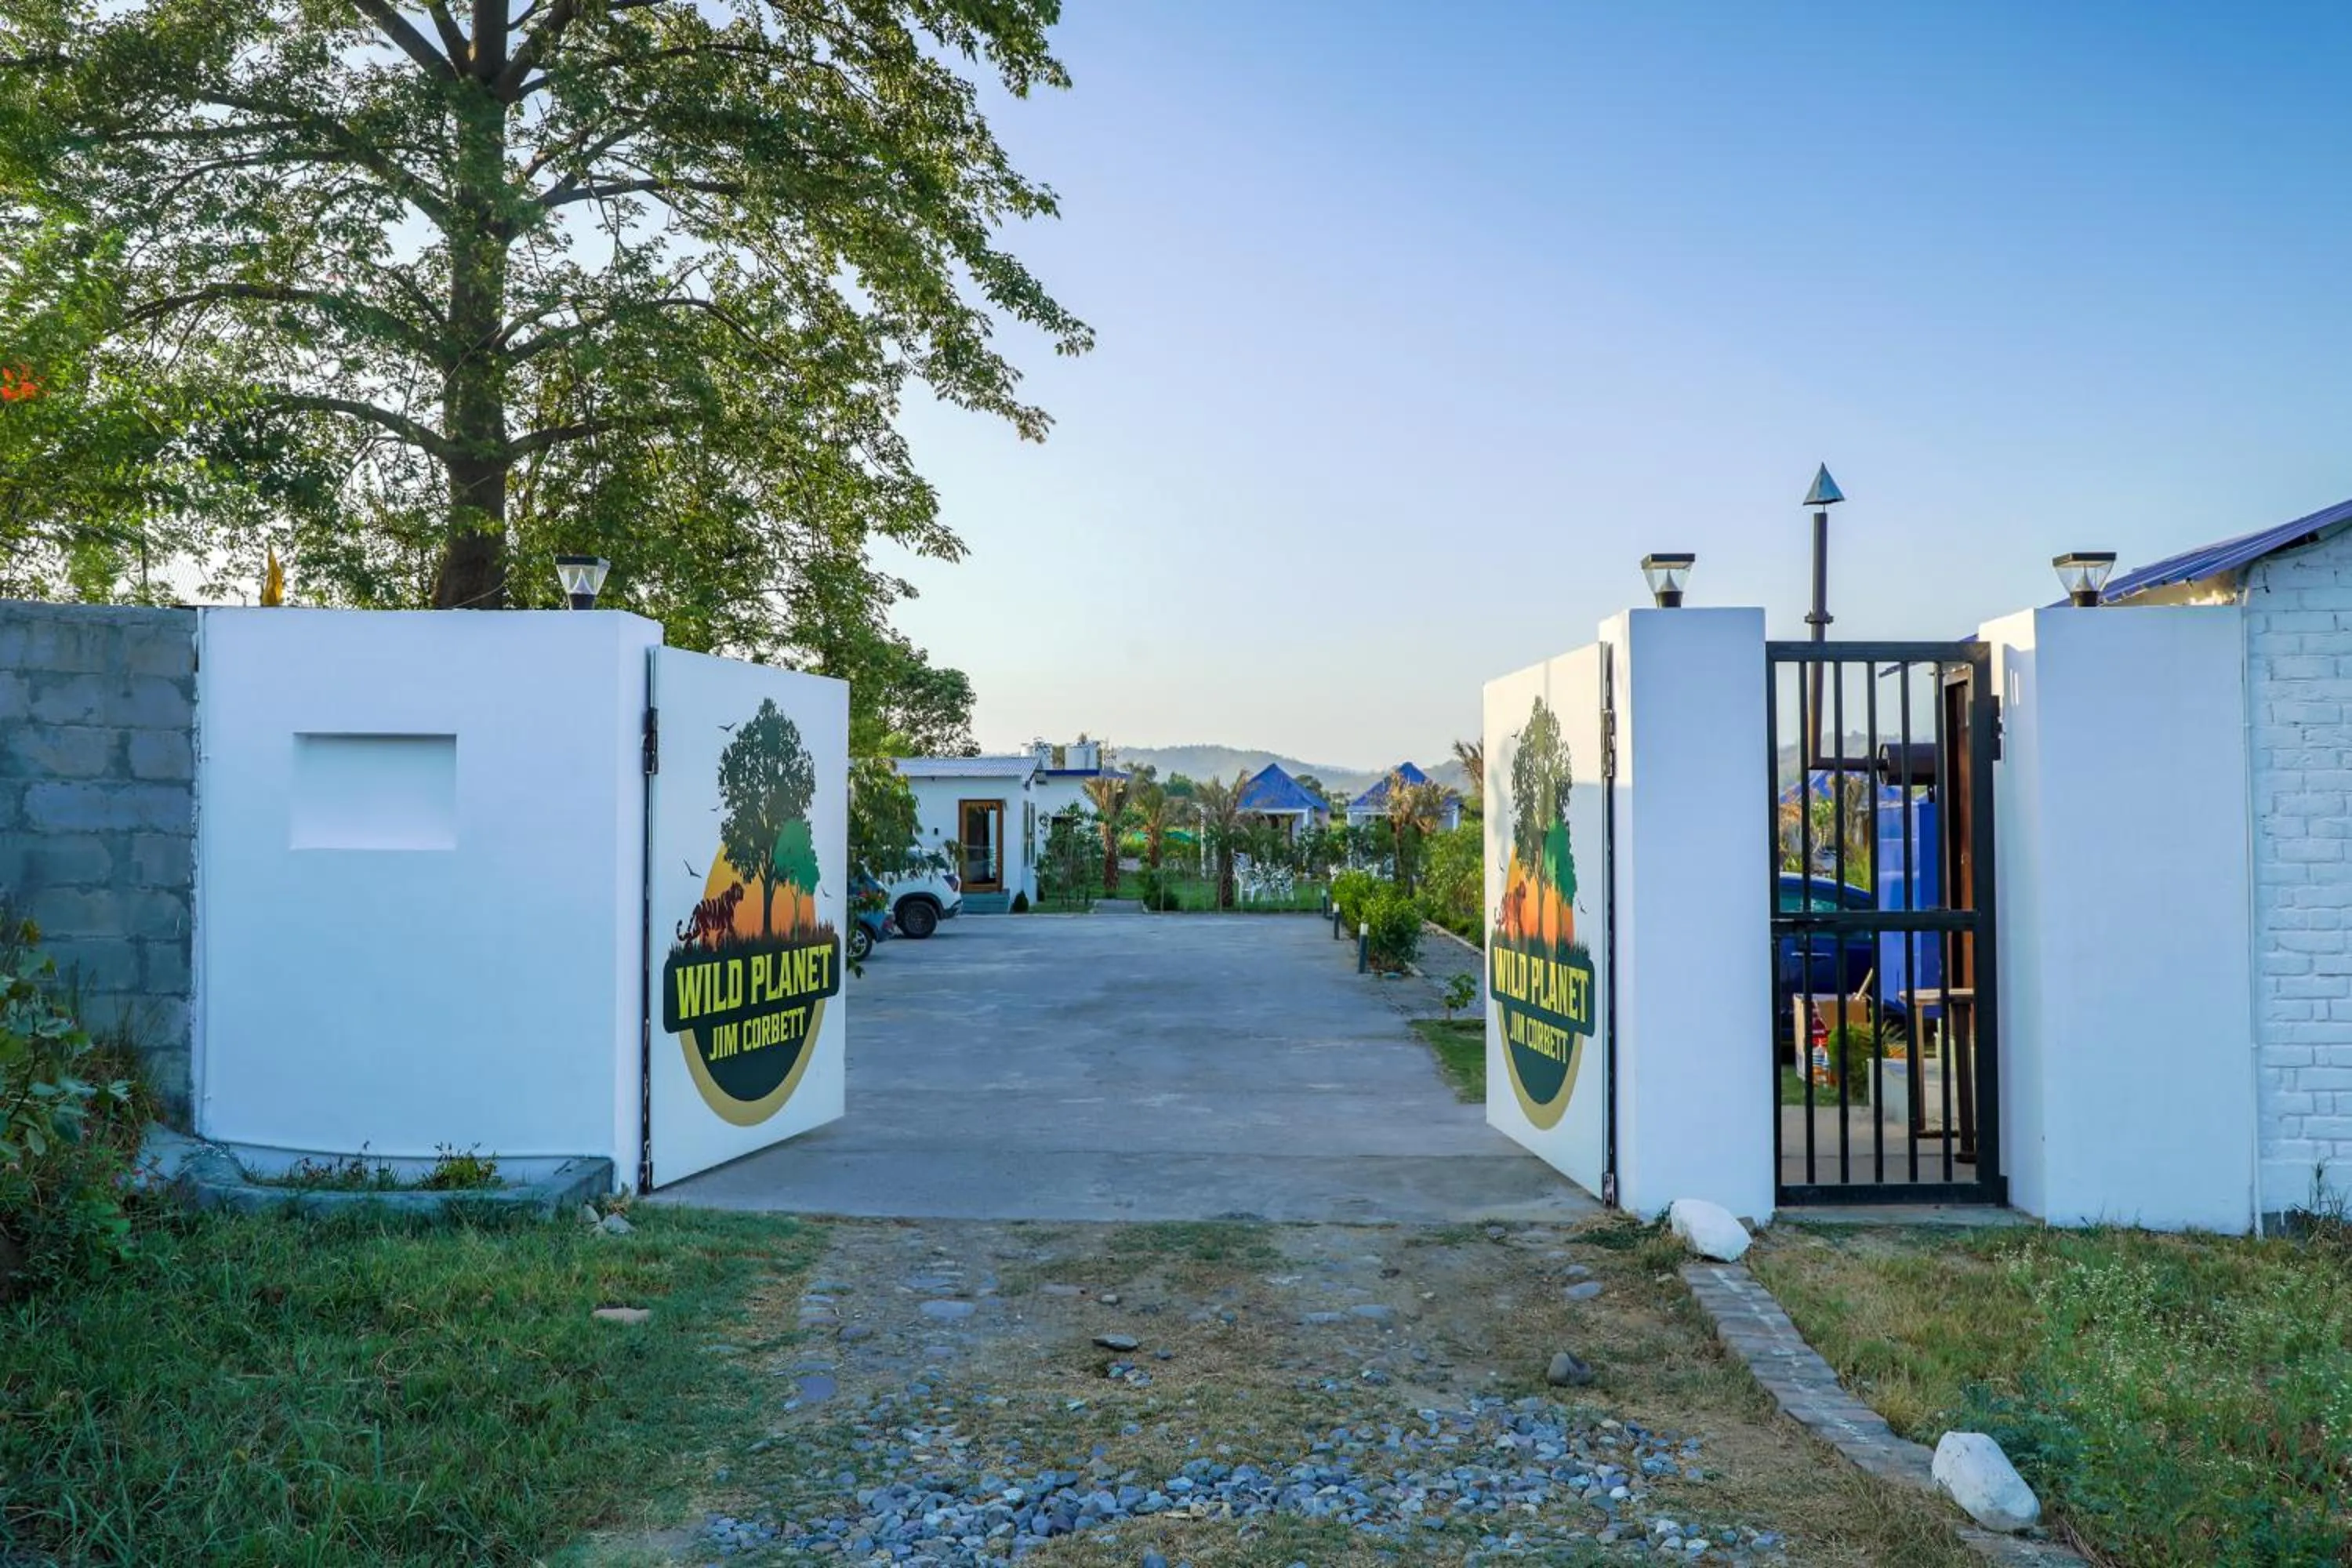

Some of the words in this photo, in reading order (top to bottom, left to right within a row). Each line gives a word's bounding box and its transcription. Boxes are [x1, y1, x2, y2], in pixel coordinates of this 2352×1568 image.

[676, 959, 742, 1019] WILD
[751, 944, 833, 1004] PLANET
[1494, 947, 1526, 1001] WILD
[1531, 956, 1588, 1023] PLANET
[710, 1022, 738, 1061] JIM
[743, 1007, 806, 1051] CORBETT
[1510, 1011, 1525, 1044] JIM
[1526, 1018, 1568, 1064] CORBETT
